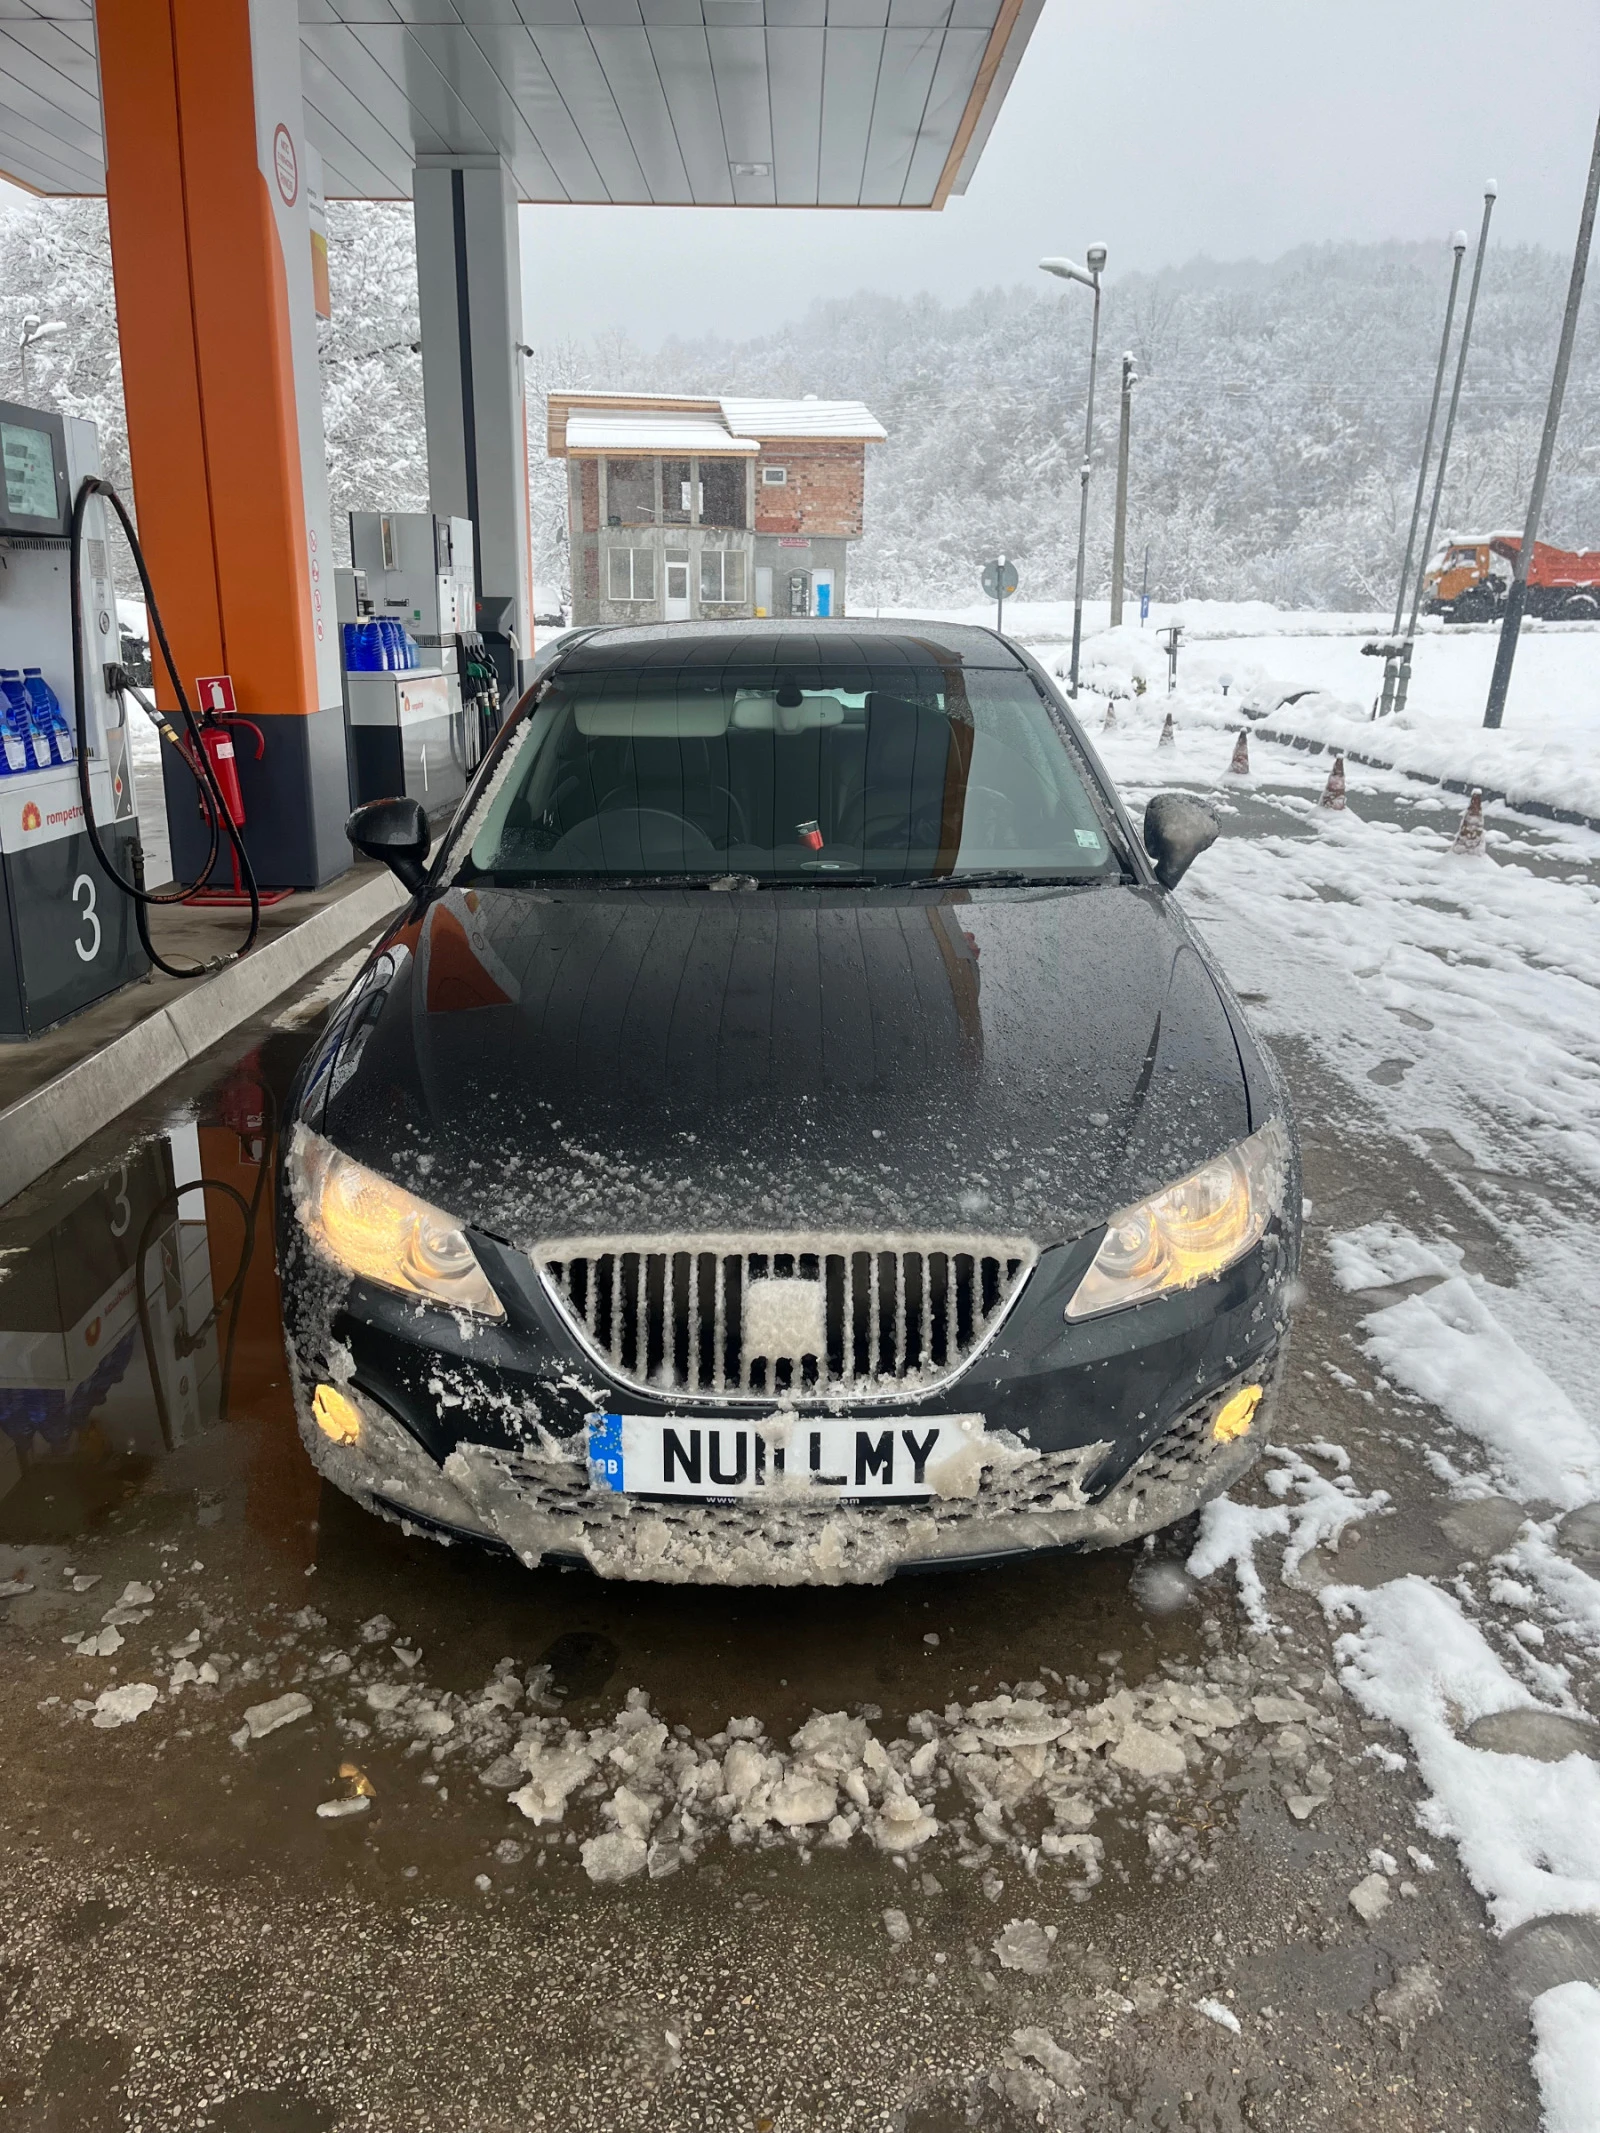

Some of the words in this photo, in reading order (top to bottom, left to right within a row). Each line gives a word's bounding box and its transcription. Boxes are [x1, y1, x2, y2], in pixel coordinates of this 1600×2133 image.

[421, 744, 428, 791] 1
[46, 804, 84, 827] rompetro
[72, 874, 101, 962] 3
[809, 1428, 940, 1486] LMY
